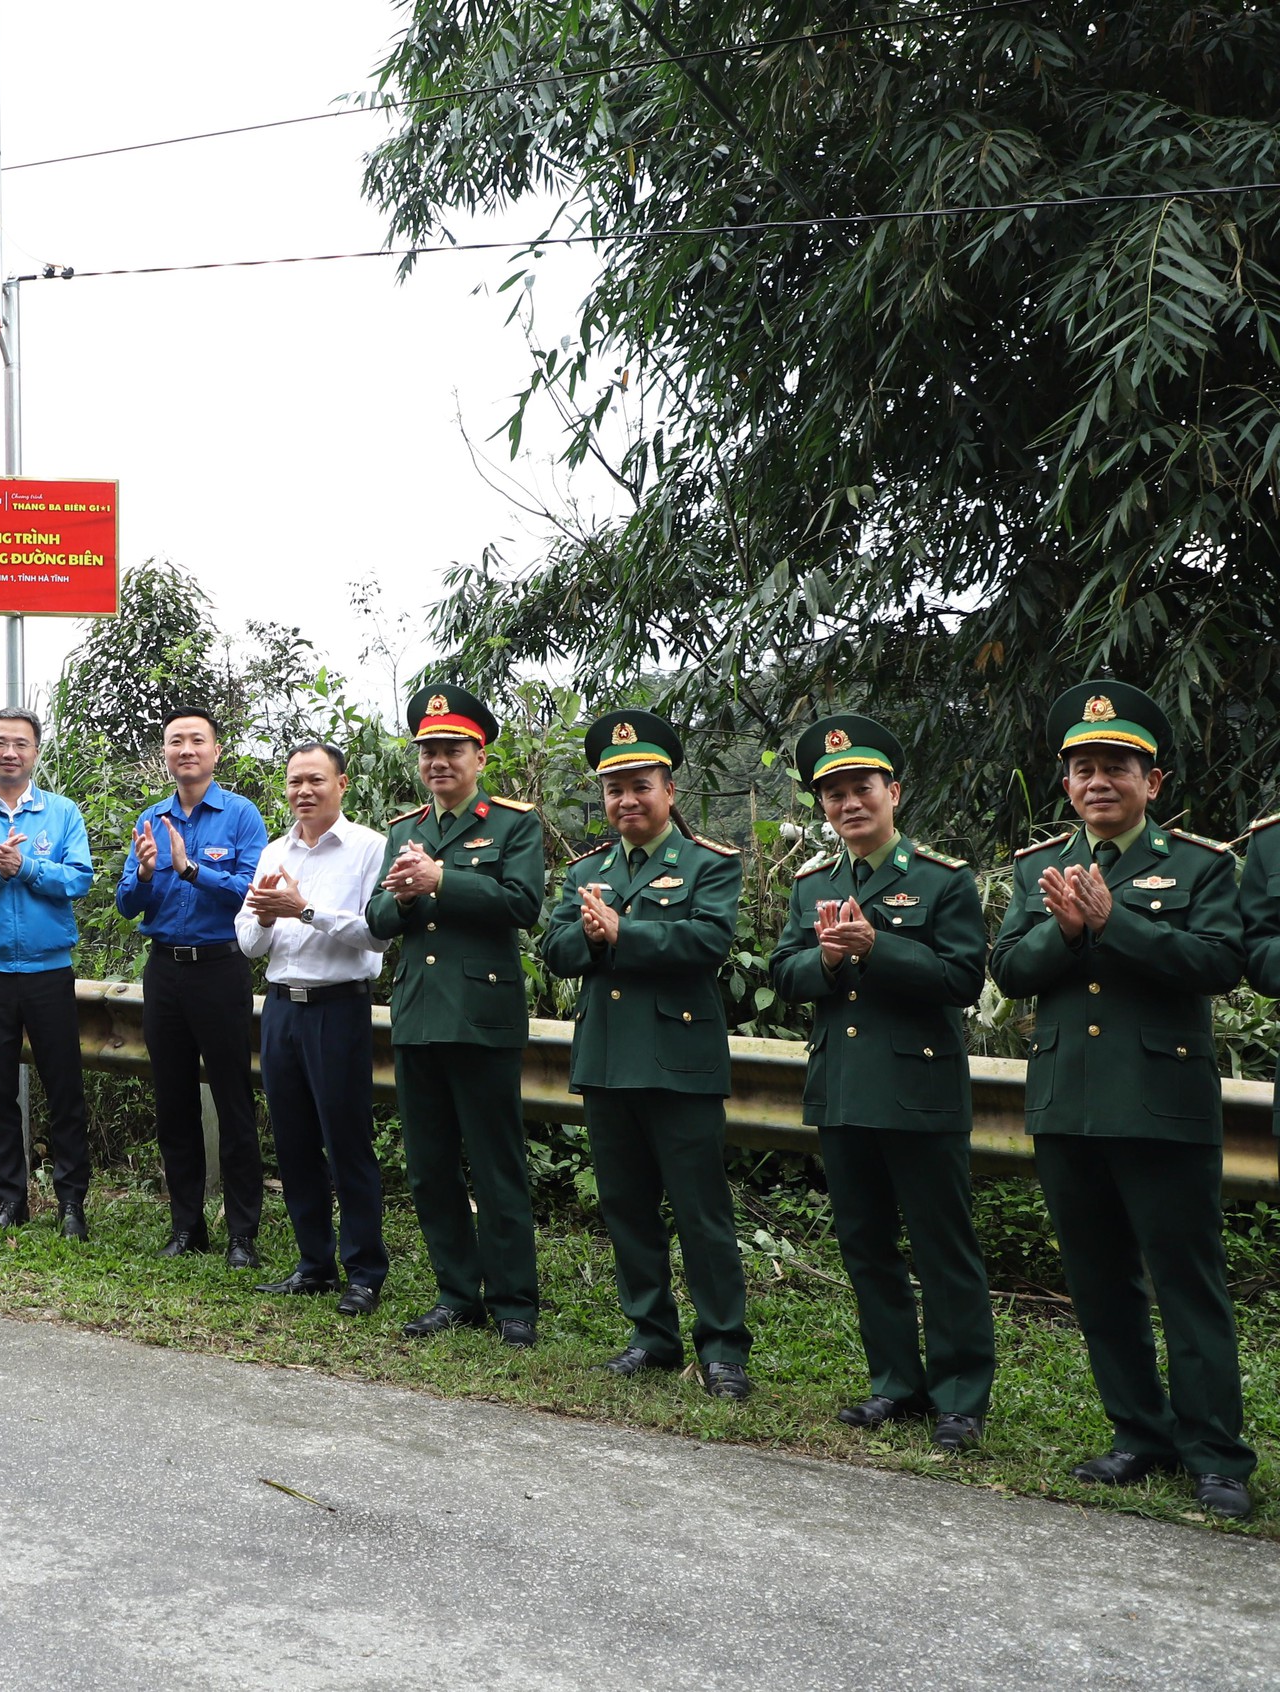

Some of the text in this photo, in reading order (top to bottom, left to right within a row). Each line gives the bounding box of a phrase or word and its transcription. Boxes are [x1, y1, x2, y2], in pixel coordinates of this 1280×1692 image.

[48, 503, 62, 511] BA
[14, 528, 61, 545] TRÌNH
[10, 548, 67, 566] ĐƯỜNG
[69, 550, 104, 566] BIÊN
[10, 574, 17, 583] 1,
[38, 574, 50, 583] HÀ
